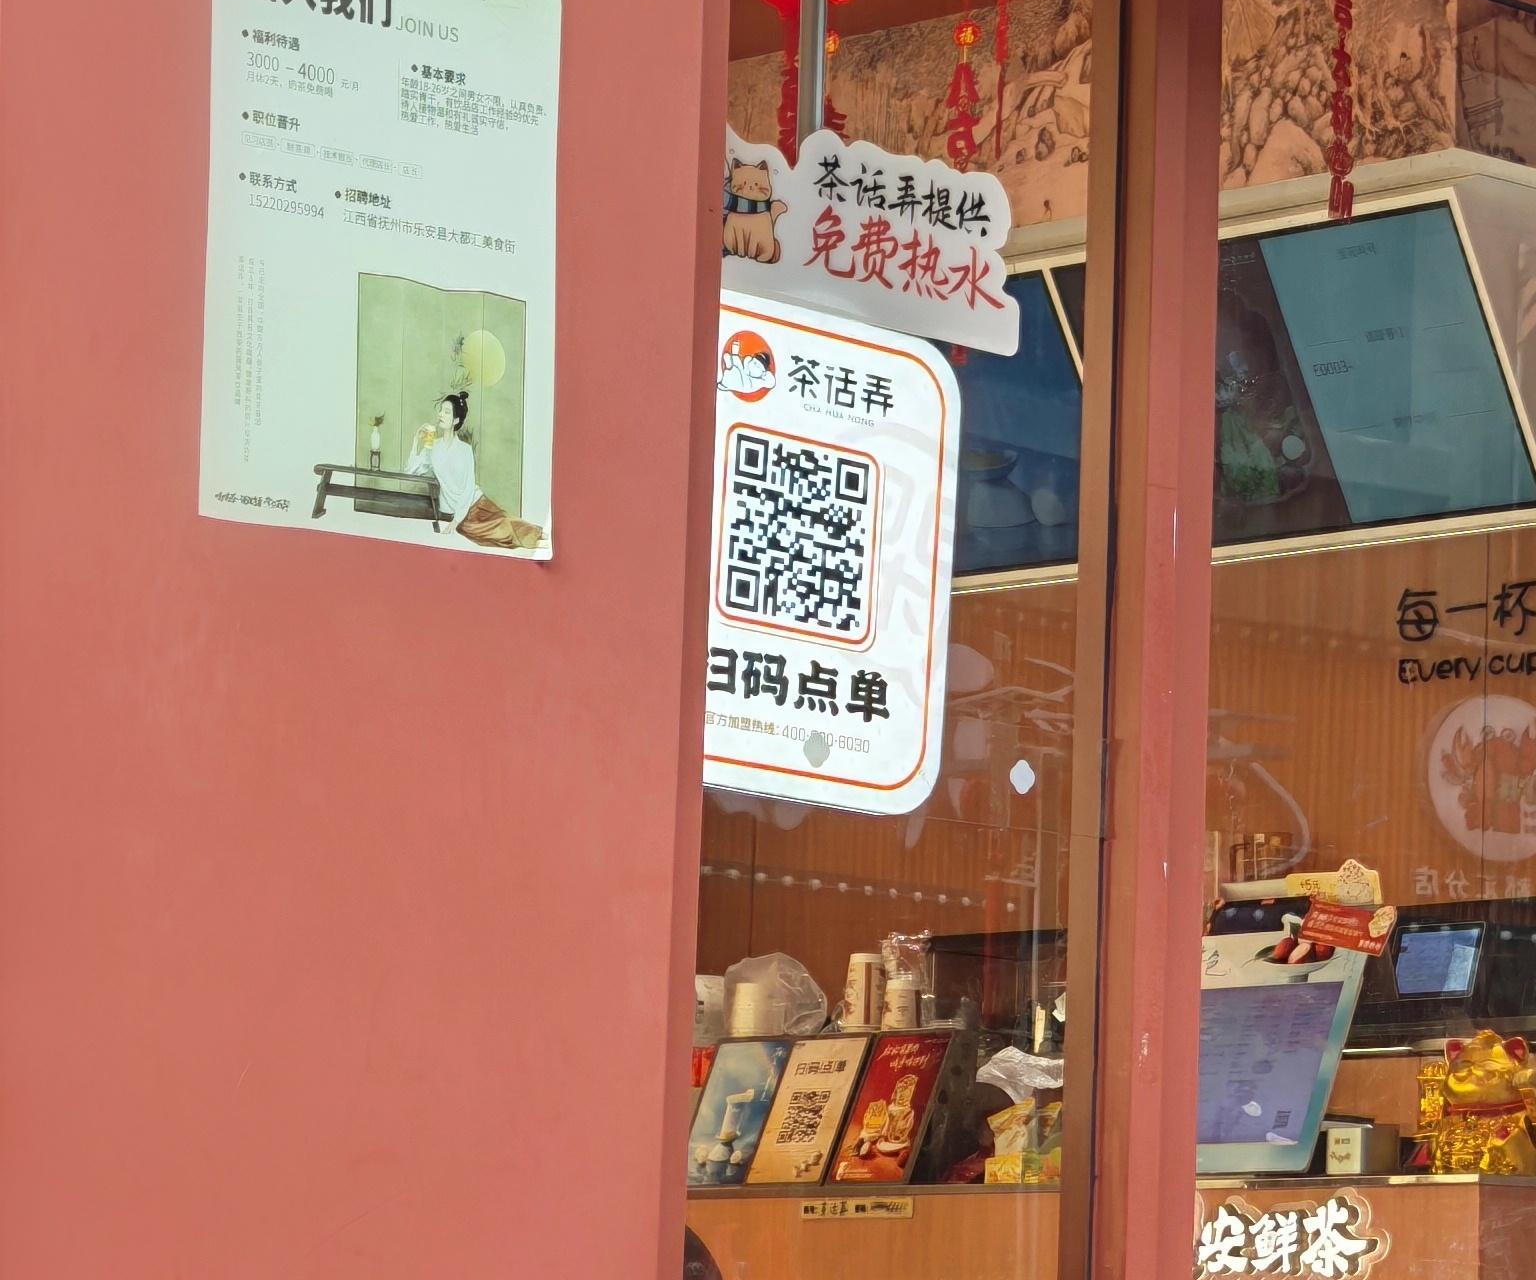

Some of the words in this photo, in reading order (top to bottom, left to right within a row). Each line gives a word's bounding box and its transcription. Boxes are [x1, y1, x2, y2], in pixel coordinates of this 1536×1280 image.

[252, 29, 300, 52] 福利待遇
[395, 14, 434, 39] JOIN
[438, 26, 460, 43] US
[247, 51, 280, 72] 3000
[297, 63, 335, 85] 4000
[421, 64, 467, 86] 基本要求
[252, 109, 301, 132] 职位晋升
[249, 171, 297, 194] 联系方式
[345, 188, 392, 210] 招聘地址
[813, 154, 992, 238] 茶话弄提供
[249, 193, 324, 219] 15220295994
[803, 205, 1006, 311] 免费热水
[788, 355, 894, 418] 茶话弄
[803, 403, 821, 414] CHA
[848, 414, 875, 427] NONG
[1398, 656, 1481, 685] Every
